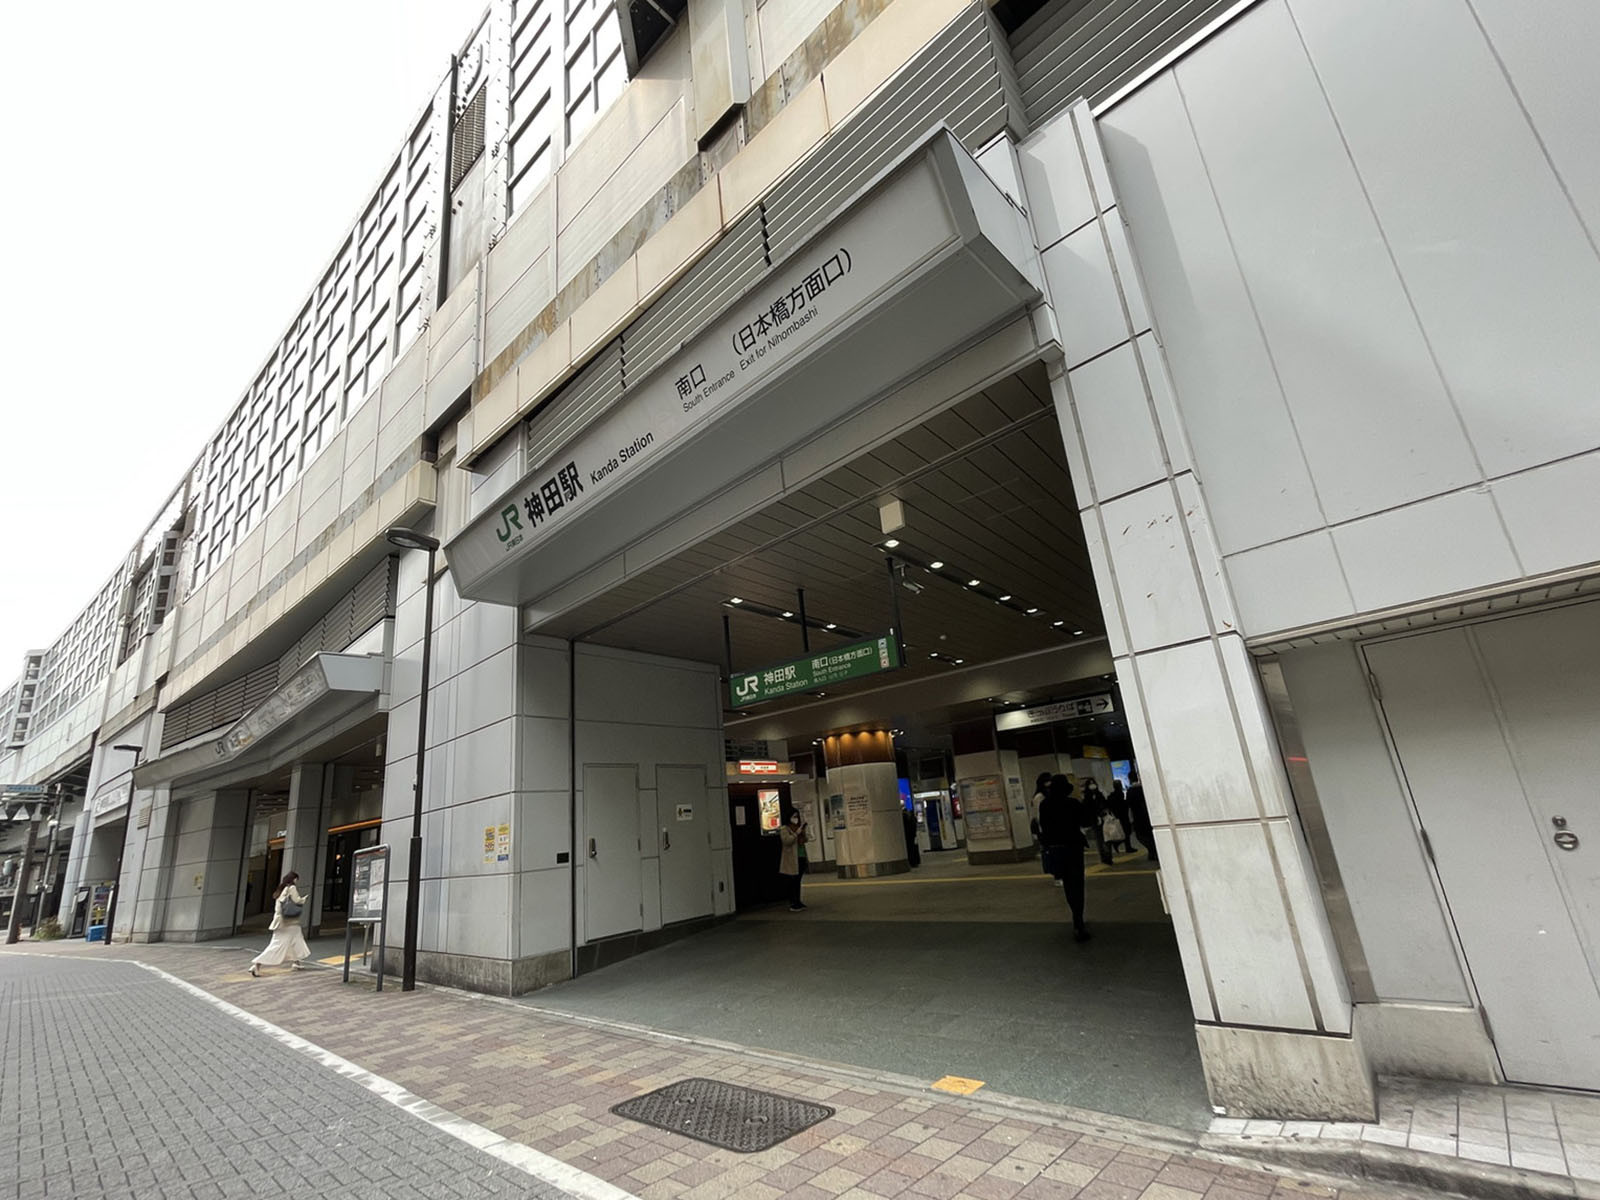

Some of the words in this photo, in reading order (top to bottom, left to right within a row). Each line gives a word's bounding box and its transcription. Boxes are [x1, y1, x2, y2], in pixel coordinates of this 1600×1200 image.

[675, 364, 706, 400] 南口
[732, 248, 852, 355] （日本橋方面口）
[683, 394, 703, 413] South
[703, 370, 735, 397] Entrance
[740, 351, 755, 371] Exit
[755, 346, 768, 360] for
[767, 306, 819, 350] Nihombashi
[496, 503, 524, 542] JR
[524, 461, 584, 528] 神田駅
[589, 458, 620, 485] Kanda
[618, 432, 655, 463] Station
[736, 675, 759, 696] JR
[763, 665, 797, 686] 神田駅
[764, 685, 785, 696] Kanda
[785, 679, 808, 690] Station
